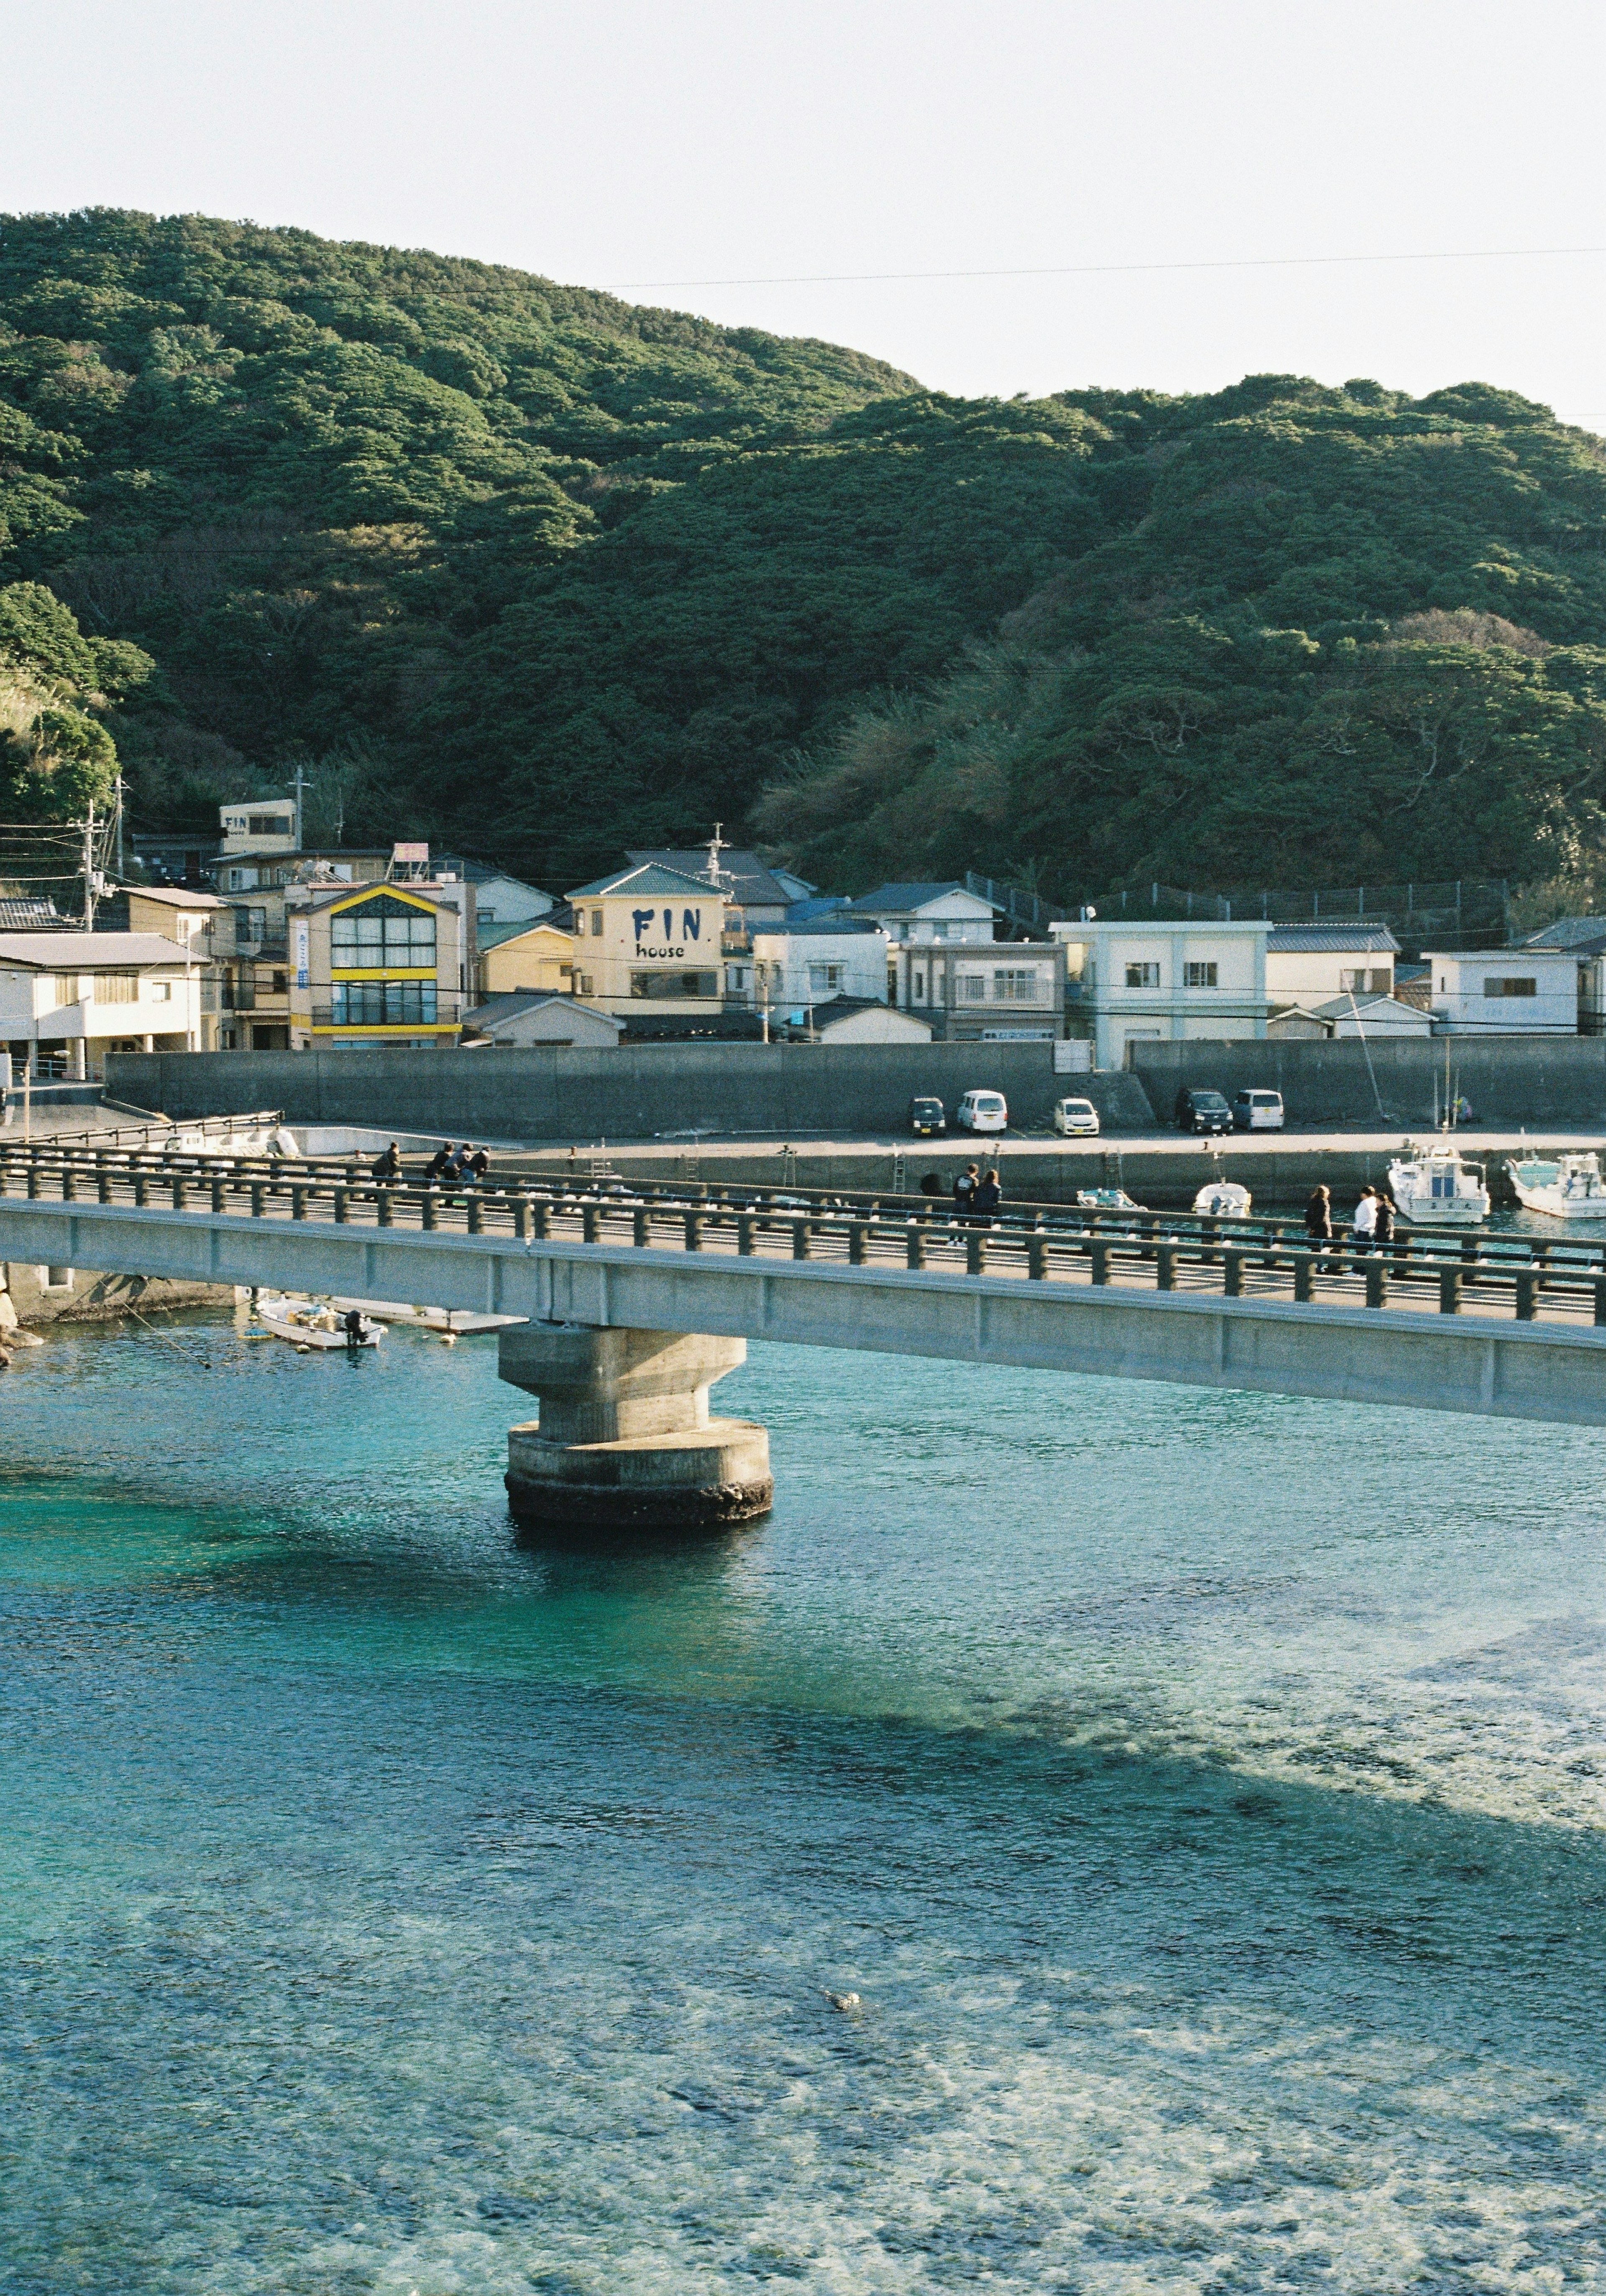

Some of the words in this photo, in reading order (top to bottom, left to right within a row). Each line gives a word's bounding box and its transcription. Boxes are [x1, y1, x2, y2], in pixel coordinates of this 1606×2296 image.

[225, 817, 246, 828] FIN
[632, 909, 700, 941] FIN
[636, 943, 684, 958] house
